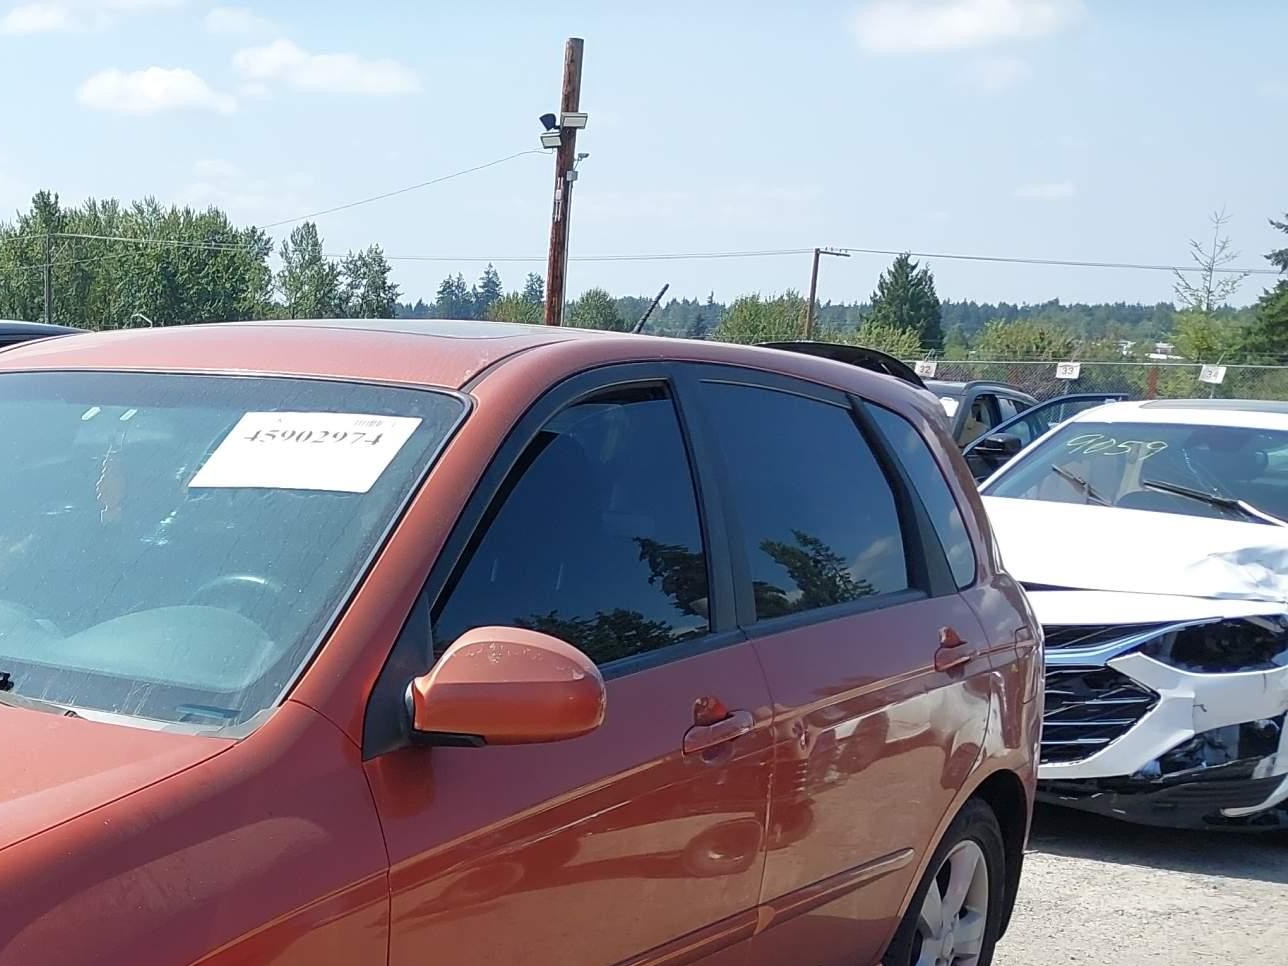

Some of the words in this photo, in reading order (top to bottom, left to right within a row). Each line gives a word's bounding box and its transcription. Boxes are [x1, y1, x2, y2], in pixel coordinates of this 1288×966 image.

[919, 365, 931, 374] 32
[1062, 366, 1074, 375] 33
[243, 429, 384, 446] 45902974
[1066, 433, 1169, 461] 9059
